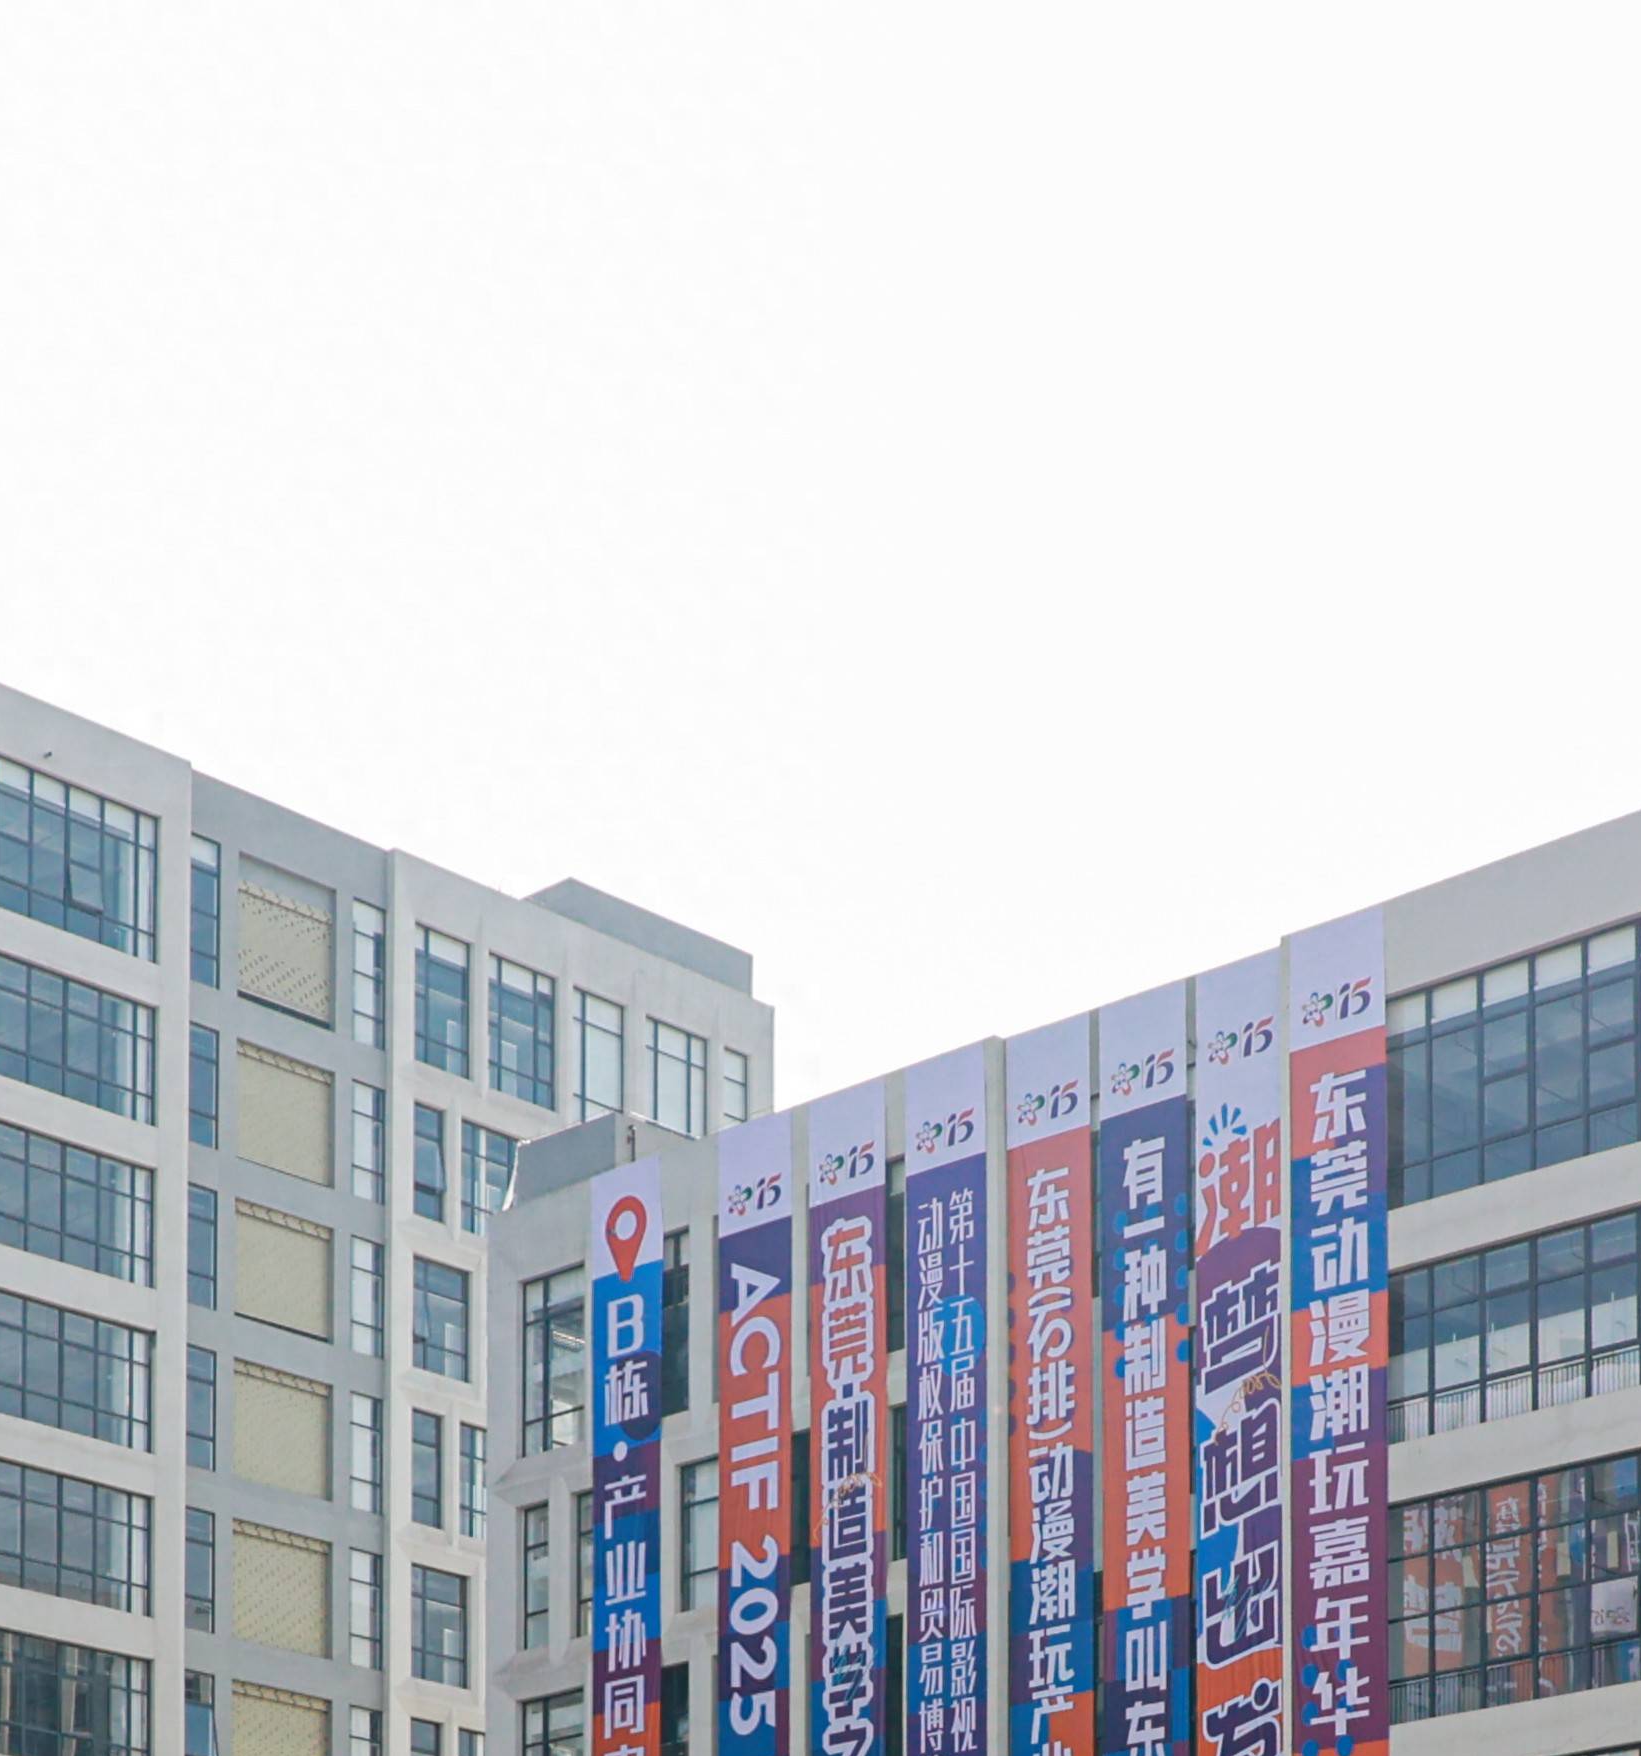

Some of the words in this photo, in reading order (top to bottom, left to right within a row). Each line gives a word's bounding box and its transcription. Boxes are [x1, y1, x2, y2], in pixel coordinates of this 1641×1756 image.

[730, 1263, 782, 1510] ACTIF
[1308, 1068, 1371, 1737] 东莞动漫潮玩嘉年华
[729, 1534, 778, 1736] 2025
